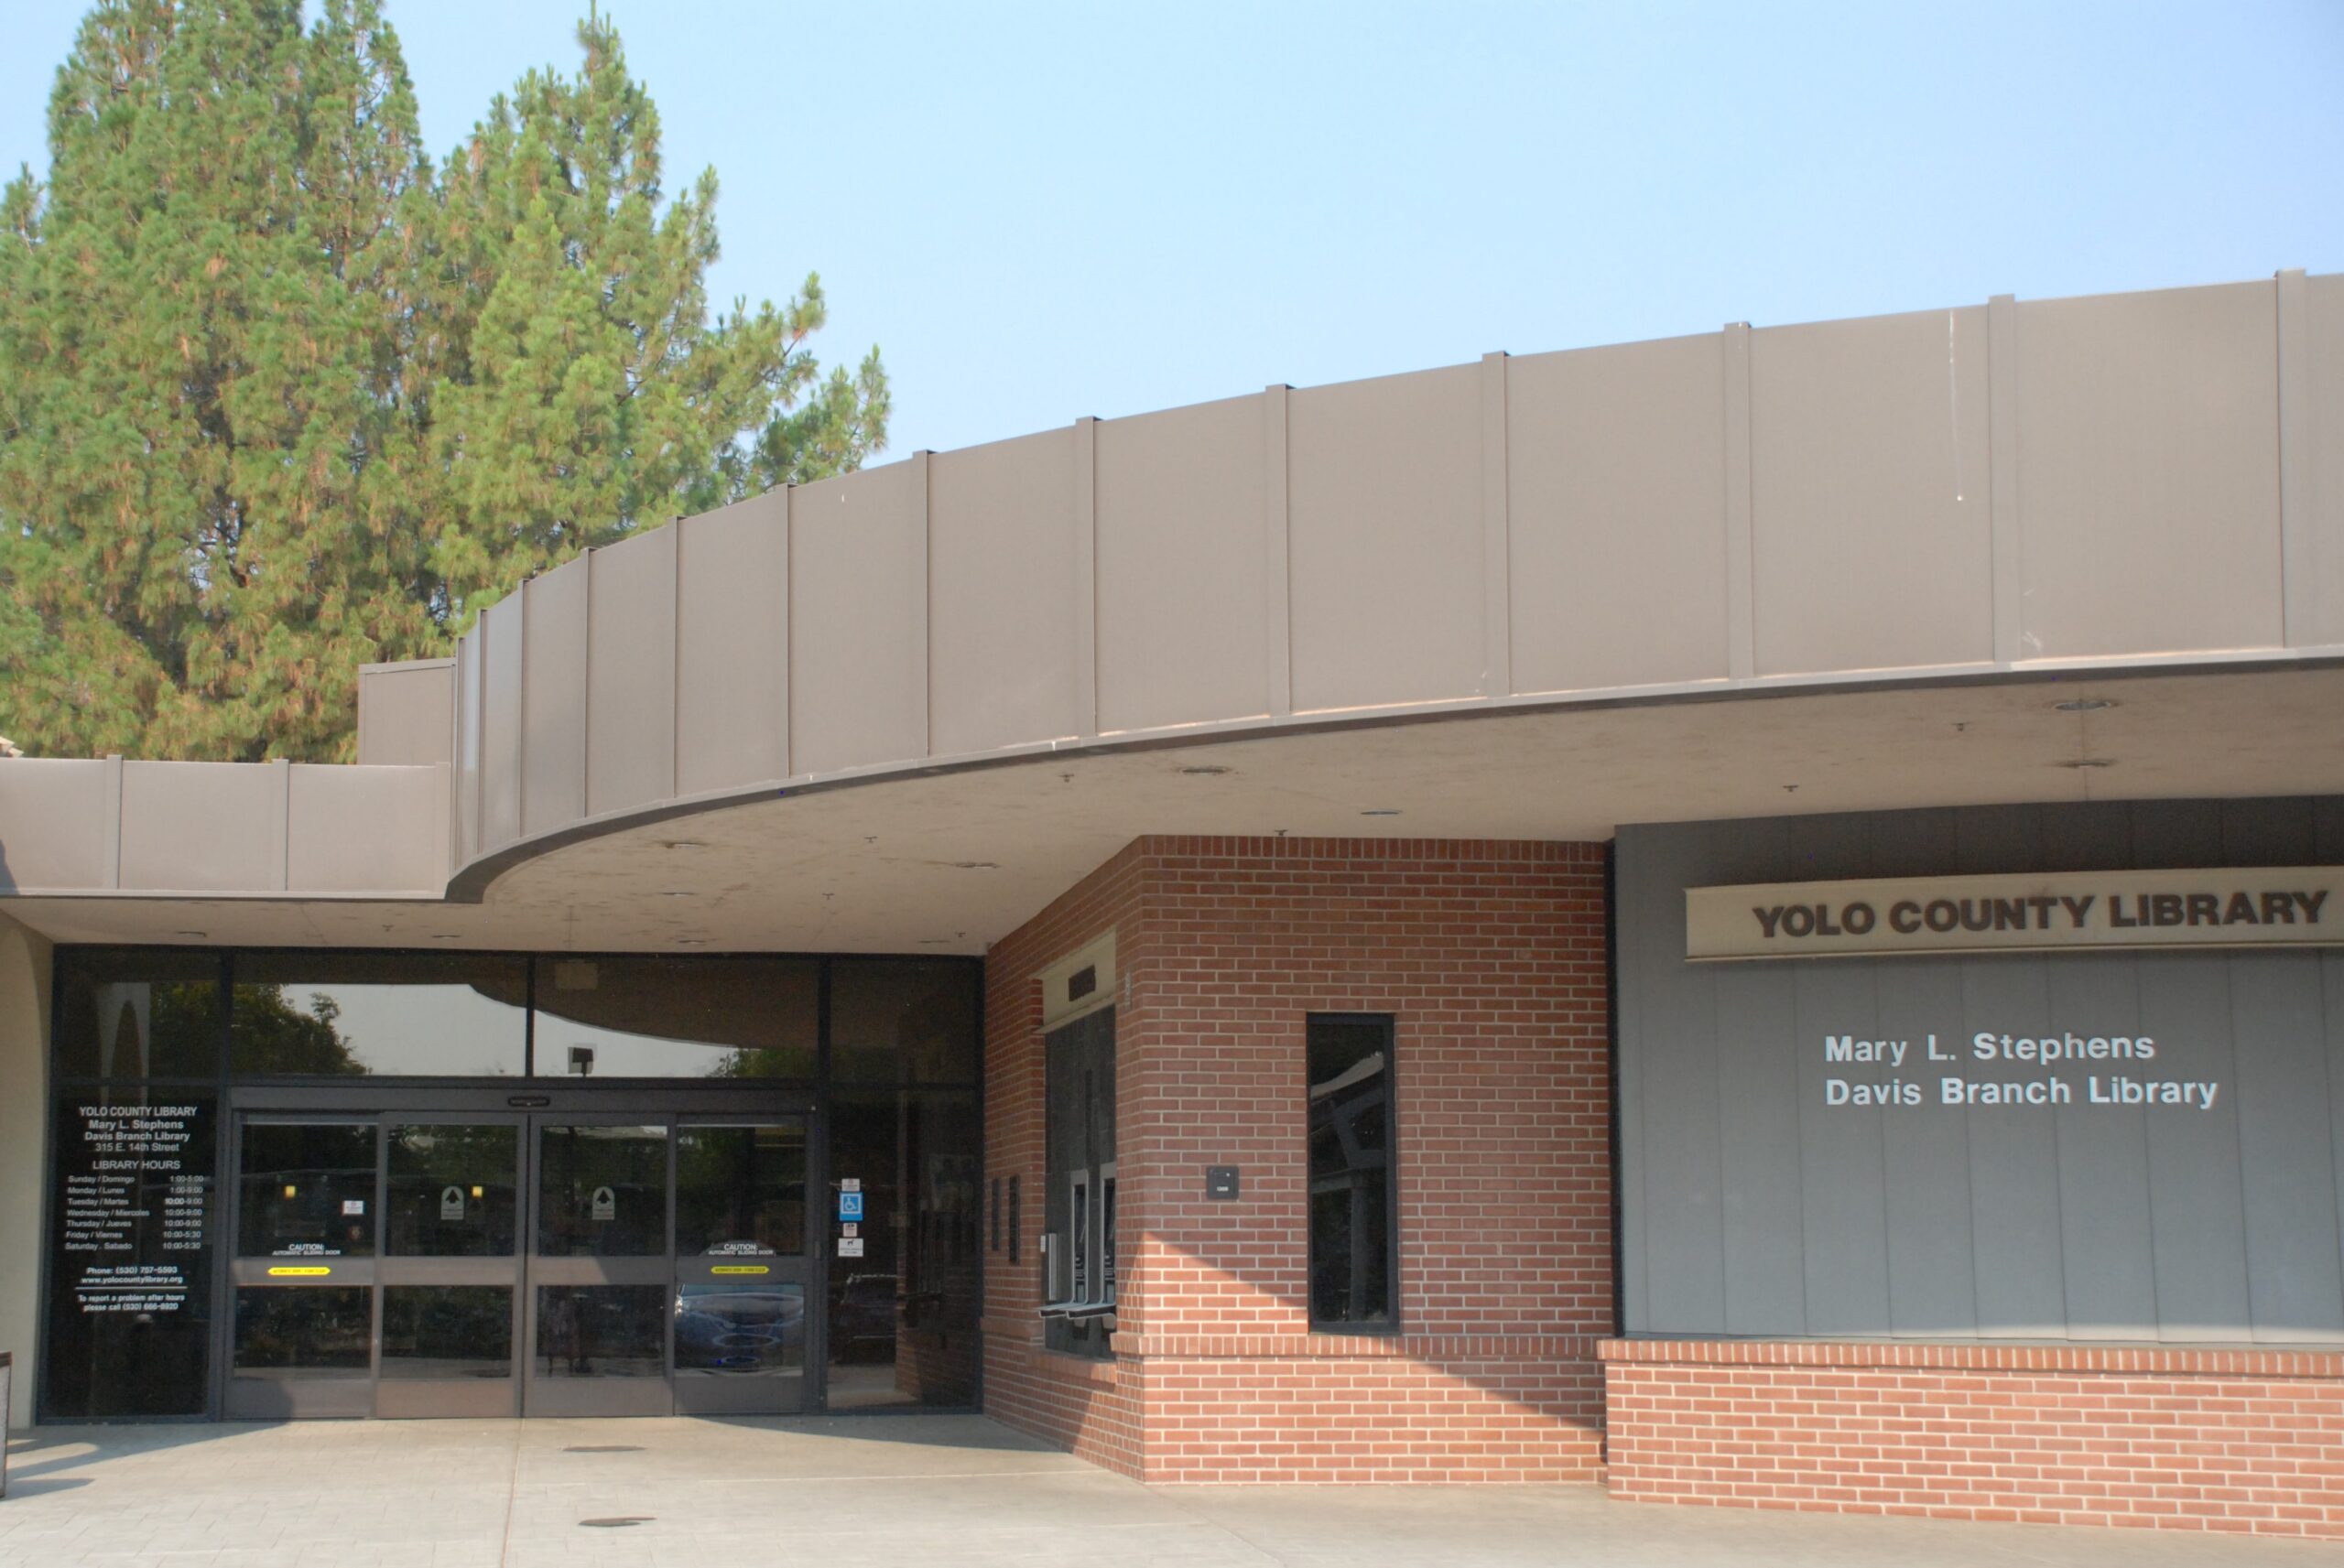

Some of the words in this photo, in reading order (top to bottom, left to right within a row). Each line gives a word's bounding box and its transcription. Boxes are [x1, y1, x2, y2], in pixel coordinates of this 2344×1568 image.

[1753, 901, 1875, 939] YOLO
[1889, 894, 2095, 935] COUNTY
[2109, 890, 2328, 928] LIBRARY
[1826, 1036, 1907, 1067] Mary
[1927, 1034, 1957, 1062] L.
[1972, 1032, 2155, 1065] Stephens
[1826, 1077, 1922, 1107] Davis
[1941, 1076, 2070, 1105] Branch
[2088, 1075, 2219, 1109] Library
[79, 1106, 108, 1117] YOLO
[109, 1106, 153, 1117] COUNTY
[153, 1106, 198, 1117] LIBRARY
[88, 1119, 117, 1131] Mary
[119, 1119, 129, 1130] L.
[132, 1119, 184, 1131] Stephens
[84, 1131, 114, 1141] Davis
[115, 1131, 152, 1141] Branch
[154, 1131, 190, 1142] Library
[95, 1142, 114, 1152] 315
[115, 1142, 126, 1152] E.
[129, 1142, 149, 1152] 14th
[151, 1142, 179, 1152] Street
[92, 1160, 139, 1170] LIBRARY
[141, 1160, 181, 1170] HOURS
[68, 1175, 97, 1184] Sunday
[102, 1175, 136, 1184] Domingo
[67, 1186, 97, 1195] Monday
[67, 1198, 98, 1207] Tuesday
[67, 1209, 109, 1217] Wednesday
[66, 1220, 103, 1228] Thursday
[65, 1231, 90, 1239] Friday
[86, 1267, 114, 1275] Phone:
[115, 1266, 138, 1275] (530)
[81, 1276, 183, 1284] www.yolocountylibrary.org
[88, 1294, 111, 1303] report
[118, 1294, 146, 1303] problem
[82, 1303, 107, 1312] please
